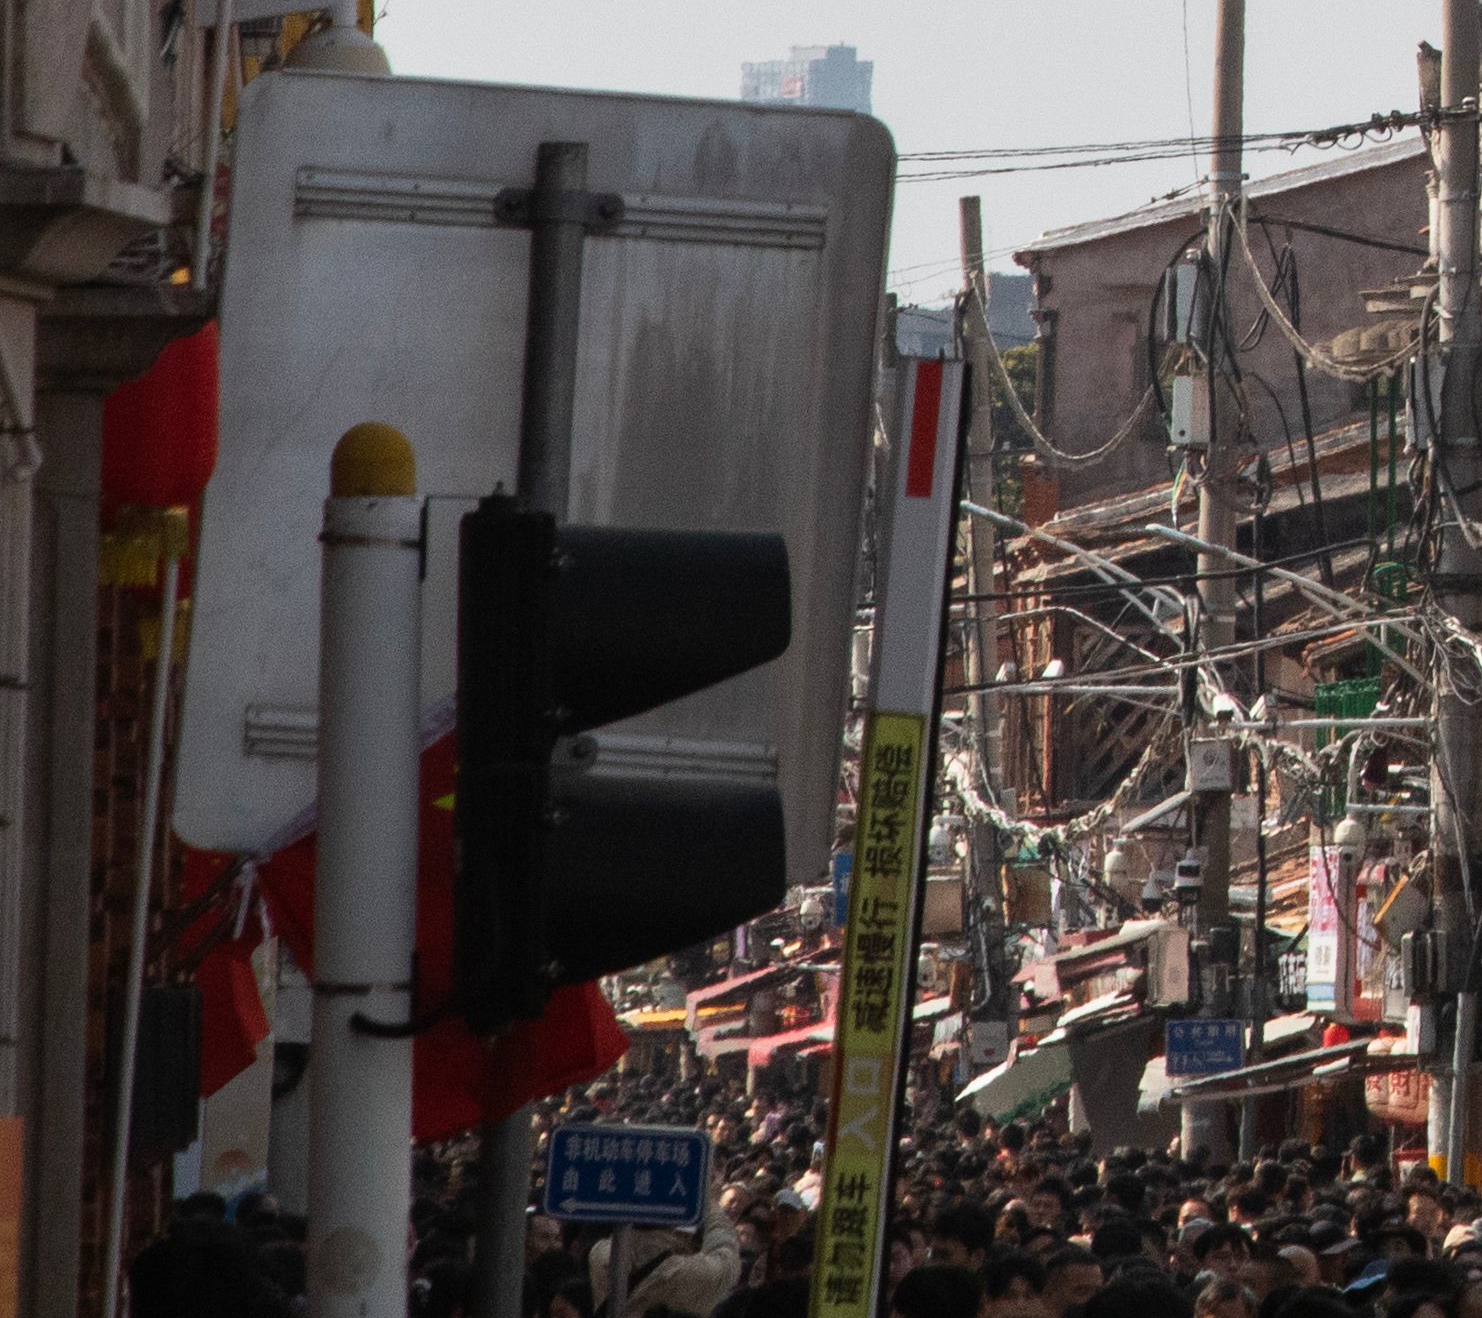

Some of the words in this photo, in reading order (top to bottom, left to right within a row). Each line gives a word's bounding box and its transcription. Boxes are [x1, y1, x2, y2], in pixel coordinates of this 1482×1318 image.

[865, 743, 913, 878] 损坏赔偿
[854, 897, 899, 1033] 减速慢行
[839, 1058, 882, 1151] 入口
[826, 1172, 870, 1306] 请勿跟车
